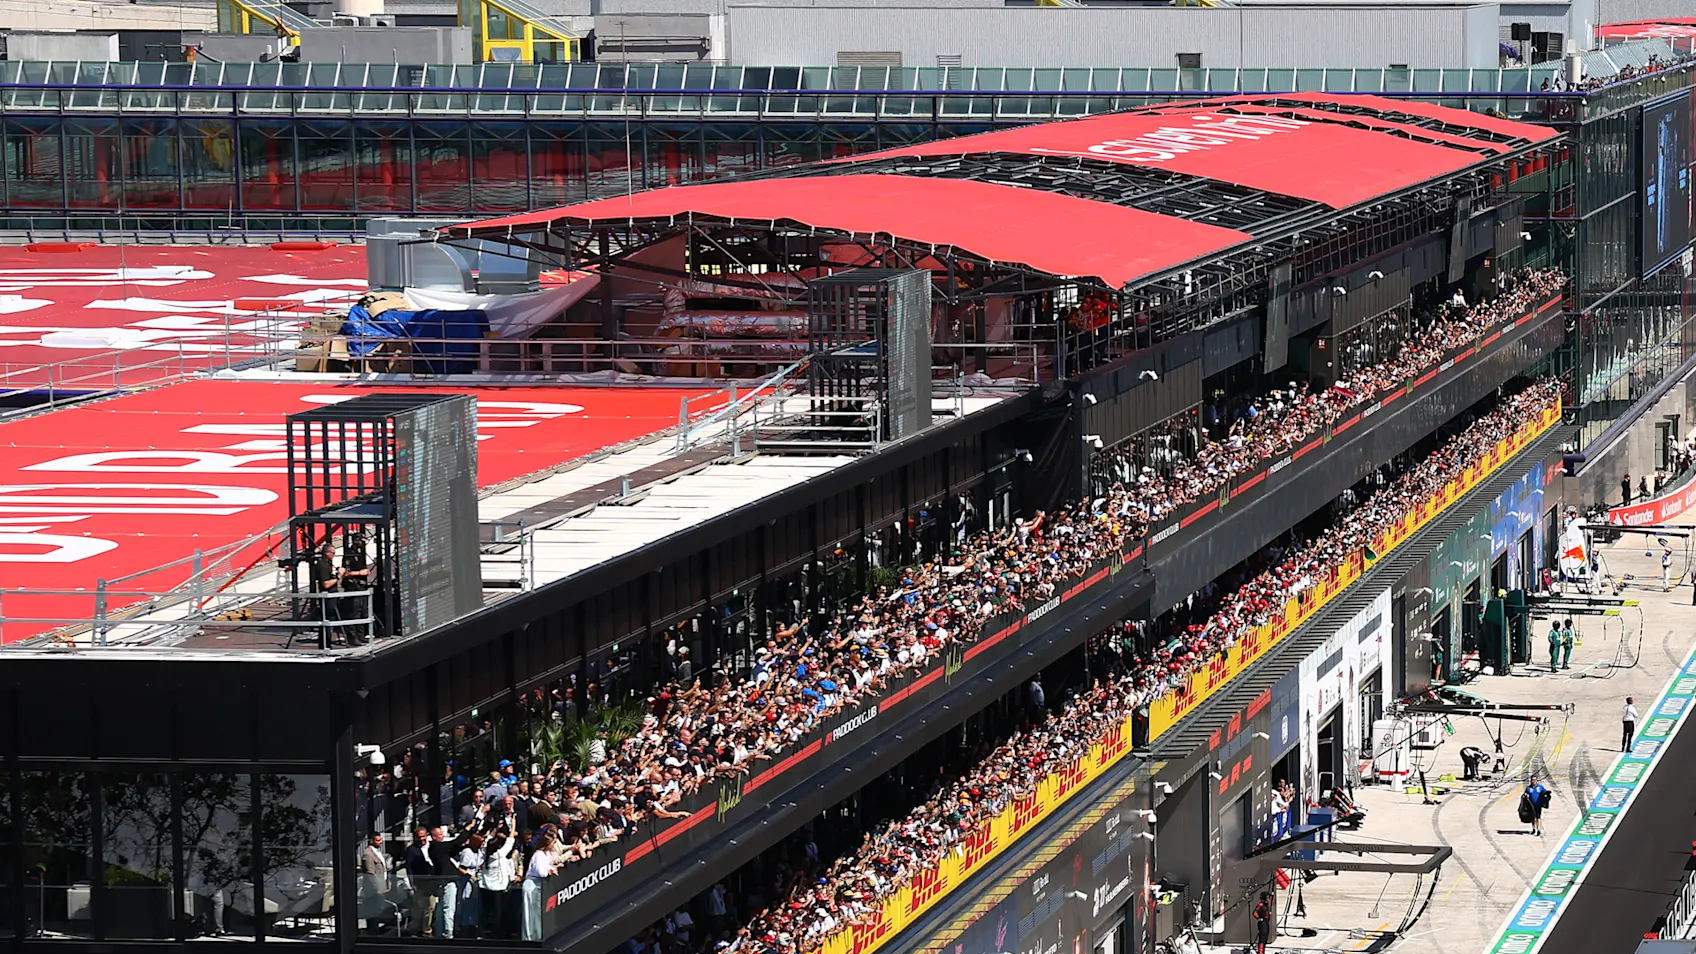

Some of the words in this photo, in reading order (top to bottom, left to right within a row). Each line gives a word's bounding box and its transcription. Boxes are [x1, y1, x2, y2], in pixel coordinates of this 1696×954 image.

[1623, 511, 1654, 526] Santander
[833, 719, 861, 741] PADDOCK
[861, 706, 877, 724] CLUB
[557, 869, 597, 904] PADDOCK
[598, 857, 621, 883] CLUB
[1538, 869, 1577, 894] aramco
[1516, 900, 1557, 927] aramco
